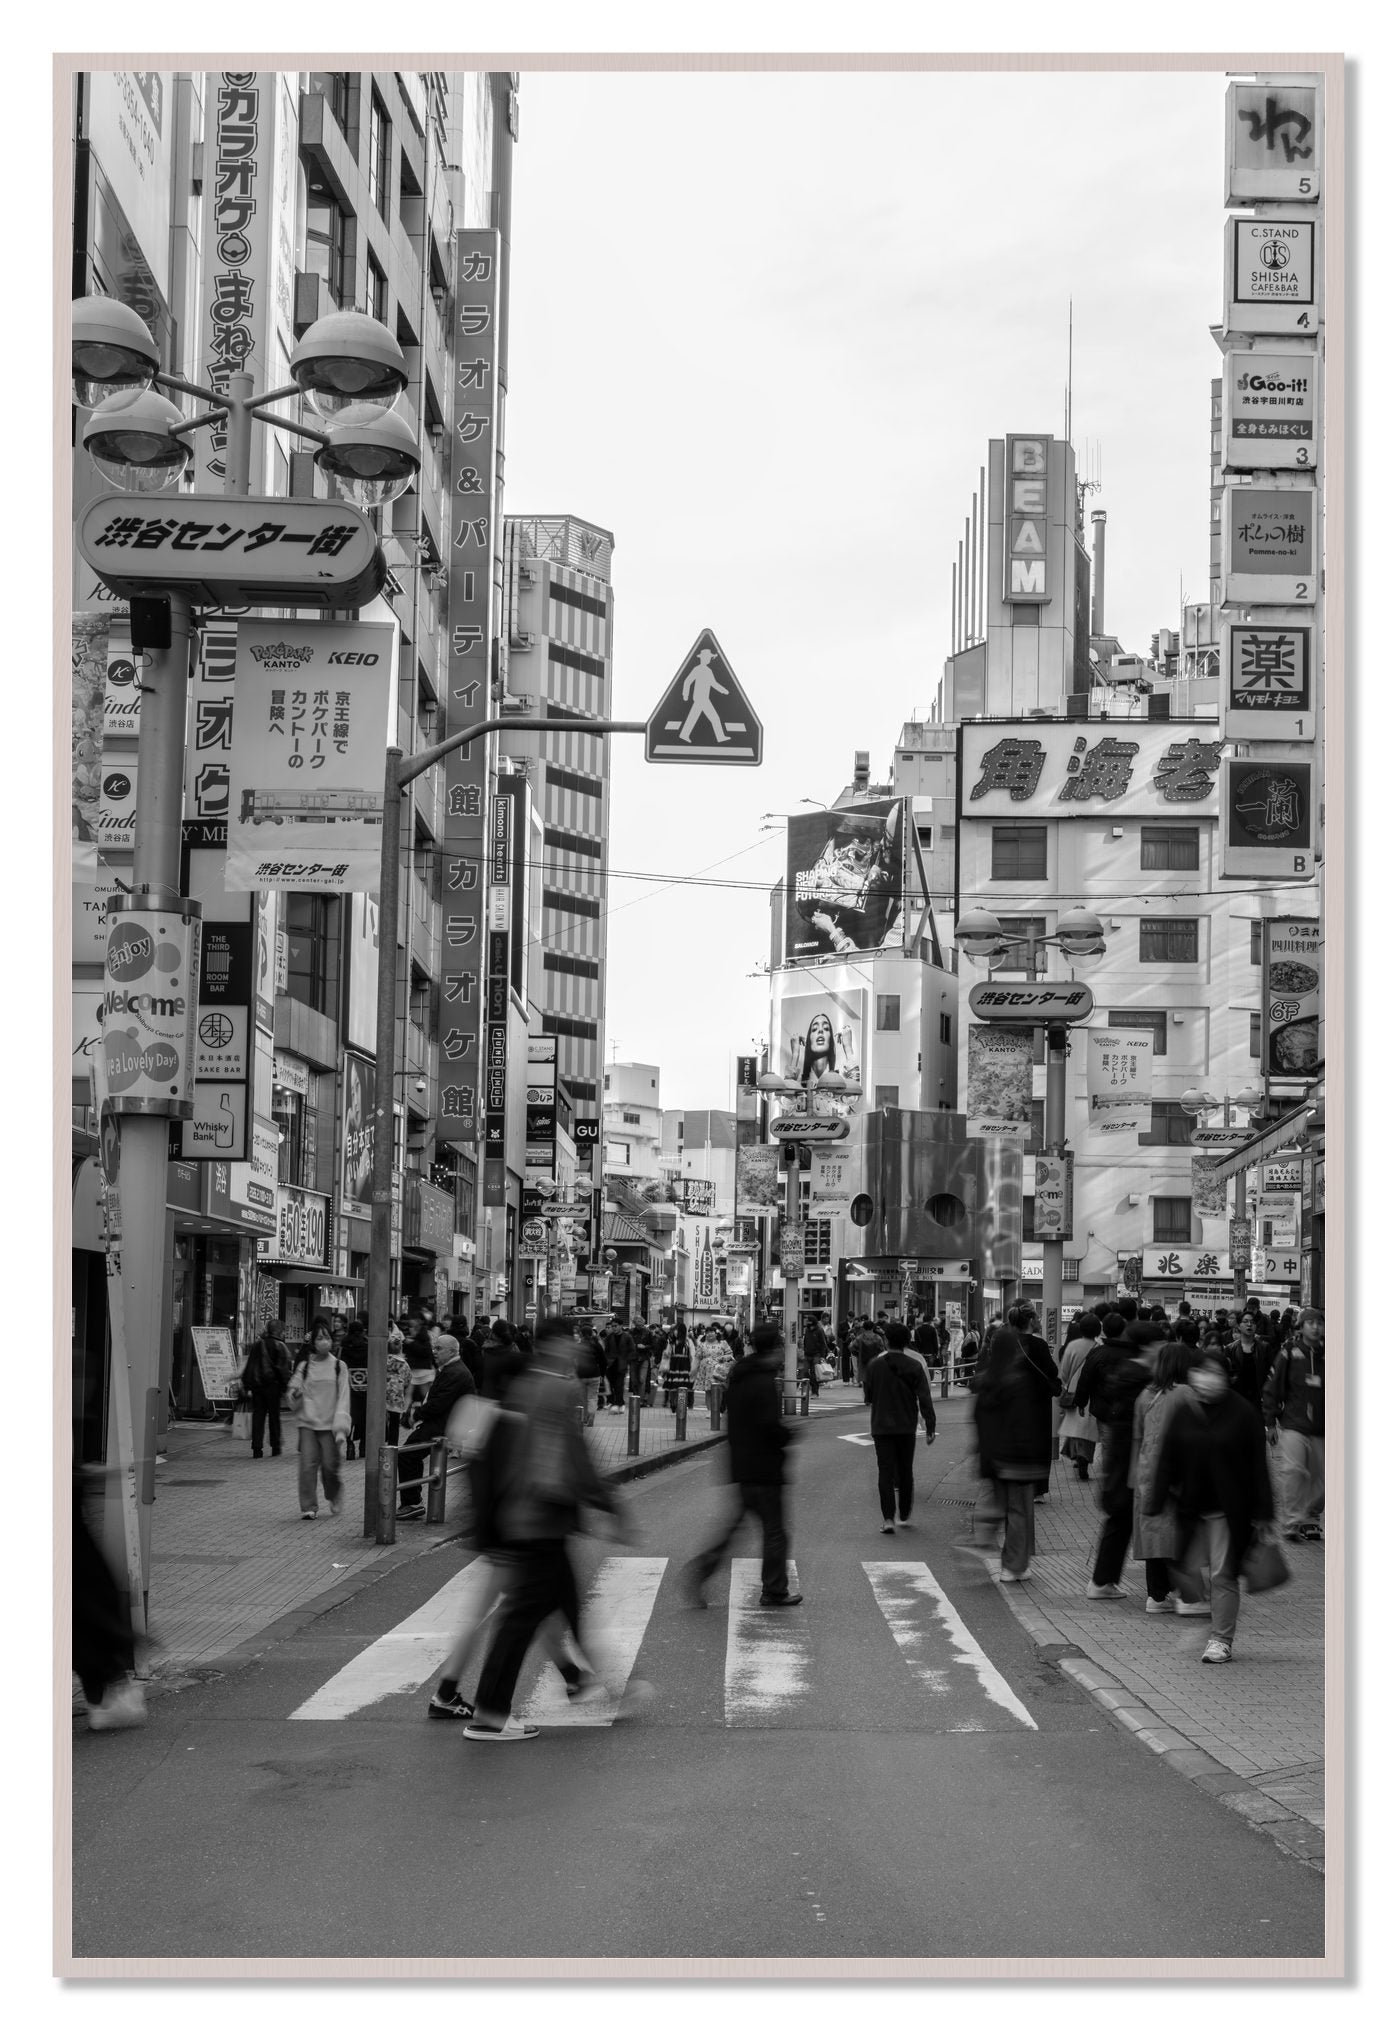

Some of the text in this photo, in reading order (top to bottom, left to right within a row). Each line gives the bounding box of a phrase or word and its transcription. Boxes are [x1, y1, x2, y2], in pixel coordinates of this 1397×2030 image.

[214, 87, 259, 234] カラオケ
[1298, 177, 1312, 194] 5
[1251, 228, 1299, 238] C.STAND
[1251, 272, 1298, 282] SHISHA
[1251, 283, 1298, 292] CAFE&BAR
[1297, 312, 1310, 328] 4
[1242, 396, 1304, 406] 渋谷宇田川町店
[1237, 423, 1308, 435] 全身もみほぐし
[1296, 447, 1308, 464] 3
[1011, 440, 1046, 594] BEAM
[94, 516, 359, 557] 渋谷センター街
[1238, 522, 1306, 544] ポムの樹
[1296, 582, 1308, 599] 2
[264, 660, 300, 668] KANTO
[328, 652, 379, 666] KEIO
[1242, 634, 1294, 688] 薬
[1235, 692, 1300, 707] マツモトキヨシ
[268, 690, 286, 736] 冒険へ
[108, 719, 134, 728] 渋谷店
[288, 690, 308, 768] カントーの
[310, 690, 329, 769] ポケパーク
[333, 691, 351, 754] 京王線で
[1295, 719, 1303, 736] 1
[969, 736, 1225, 802] 角海老
[1236, 778, 1300, 830] 一蘭
[496, 800, 506, 838] kimono
[104, 833, 130, 842] 渋谷店
[255, 862, 350, 877] 渋谷センター街
[1294, 856, 1306, 872] B
[206, 942, 230, 950] THIRD
[212, 936, 226, 944] THE
[108, 936, 150, 974] Enjoy
[210, 984, 225, 992] BAR
[441, 859, 478, 1120] カラオケ館
[977, 992, 1086, 1006] 渋谷センター街
[1270, 1001, 1300, 1022] 6F
[135, 1012, 155, 1033] Shibuya
[122, 1050, 154, 1074] Lovely
[156, 1053, 176, 1067] Day!
[194, 1122, 229, 1134] Whisky
[576, 1126, 598, 1137] GU
[774, 1122, 839, 1132] 渋谷センター街
[1100, 1122, 1138, 1130] 渋谷センター街
[193, 1132, 214, 1142] Bank
[1158, 1252, 1221, 1275] 兆楽
[702, 1251, 712, 1295] BEER
